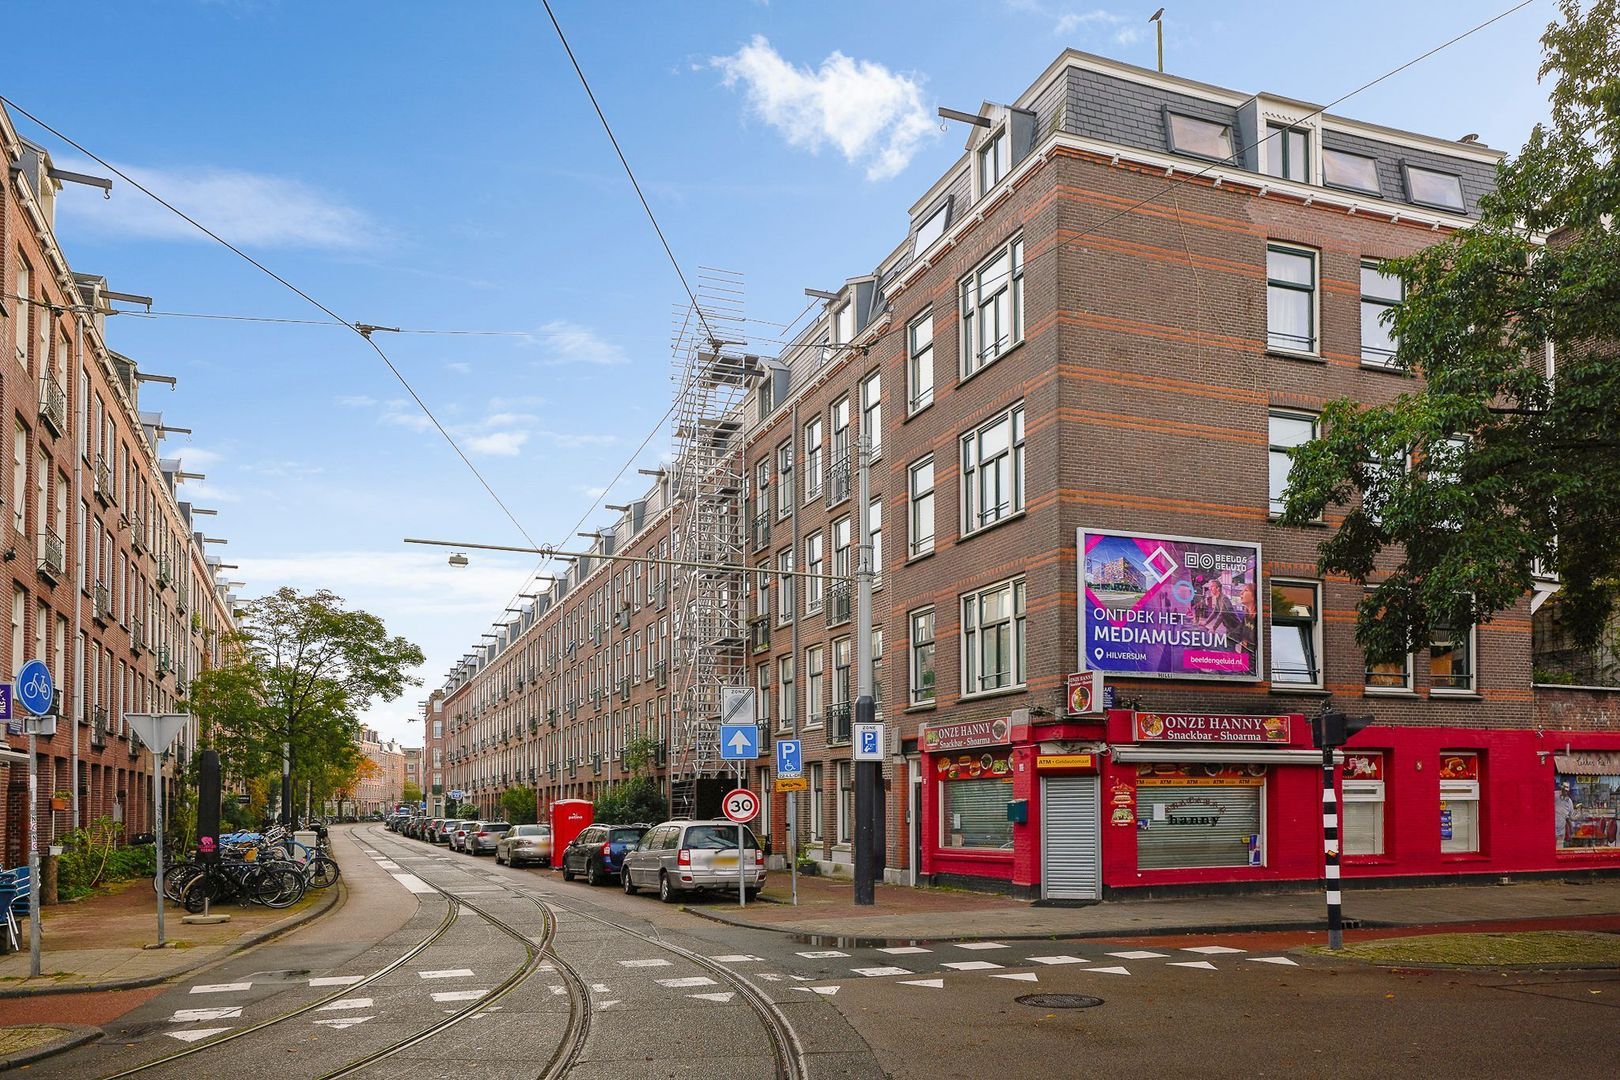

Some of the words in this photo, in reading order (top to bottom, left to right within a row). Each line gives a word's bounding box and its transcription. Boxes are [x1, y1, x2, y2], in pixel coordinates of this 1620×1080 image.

[1215, 554, 1247, 564] BEELD&
[1215, 562, 1247, 572] GELUID
[1094, 607, 1154, 624] ONTDEK
[1158, 612, 1186, 625] HET
[1094, 626, 1228, 648] MEDIAMUSEUM
[1106, 652, 1147, 660] HILVERSUM
[1190, 656, 1242, 665] beeldengeluid.nl
[1166, 716, 1206, 728] ONZE
[1210, 718, 1262, 730] HANNY
[938, 726, 960, 739] ONZE
[960, 722, 991, 736] HANNY
[1168, 730, 1212, 740] Snackbar
[1220, 731, 1261, 741] Shoarma
[865, 733, 874, 744] P
[940, 739, 963, 748] Snackbar
[966, 737, 990, 746] Shoarma
[782, 742, 796, 760] P
[730, 799, 752, 812] 30
[1168, 814, 1220, 827] hanny
